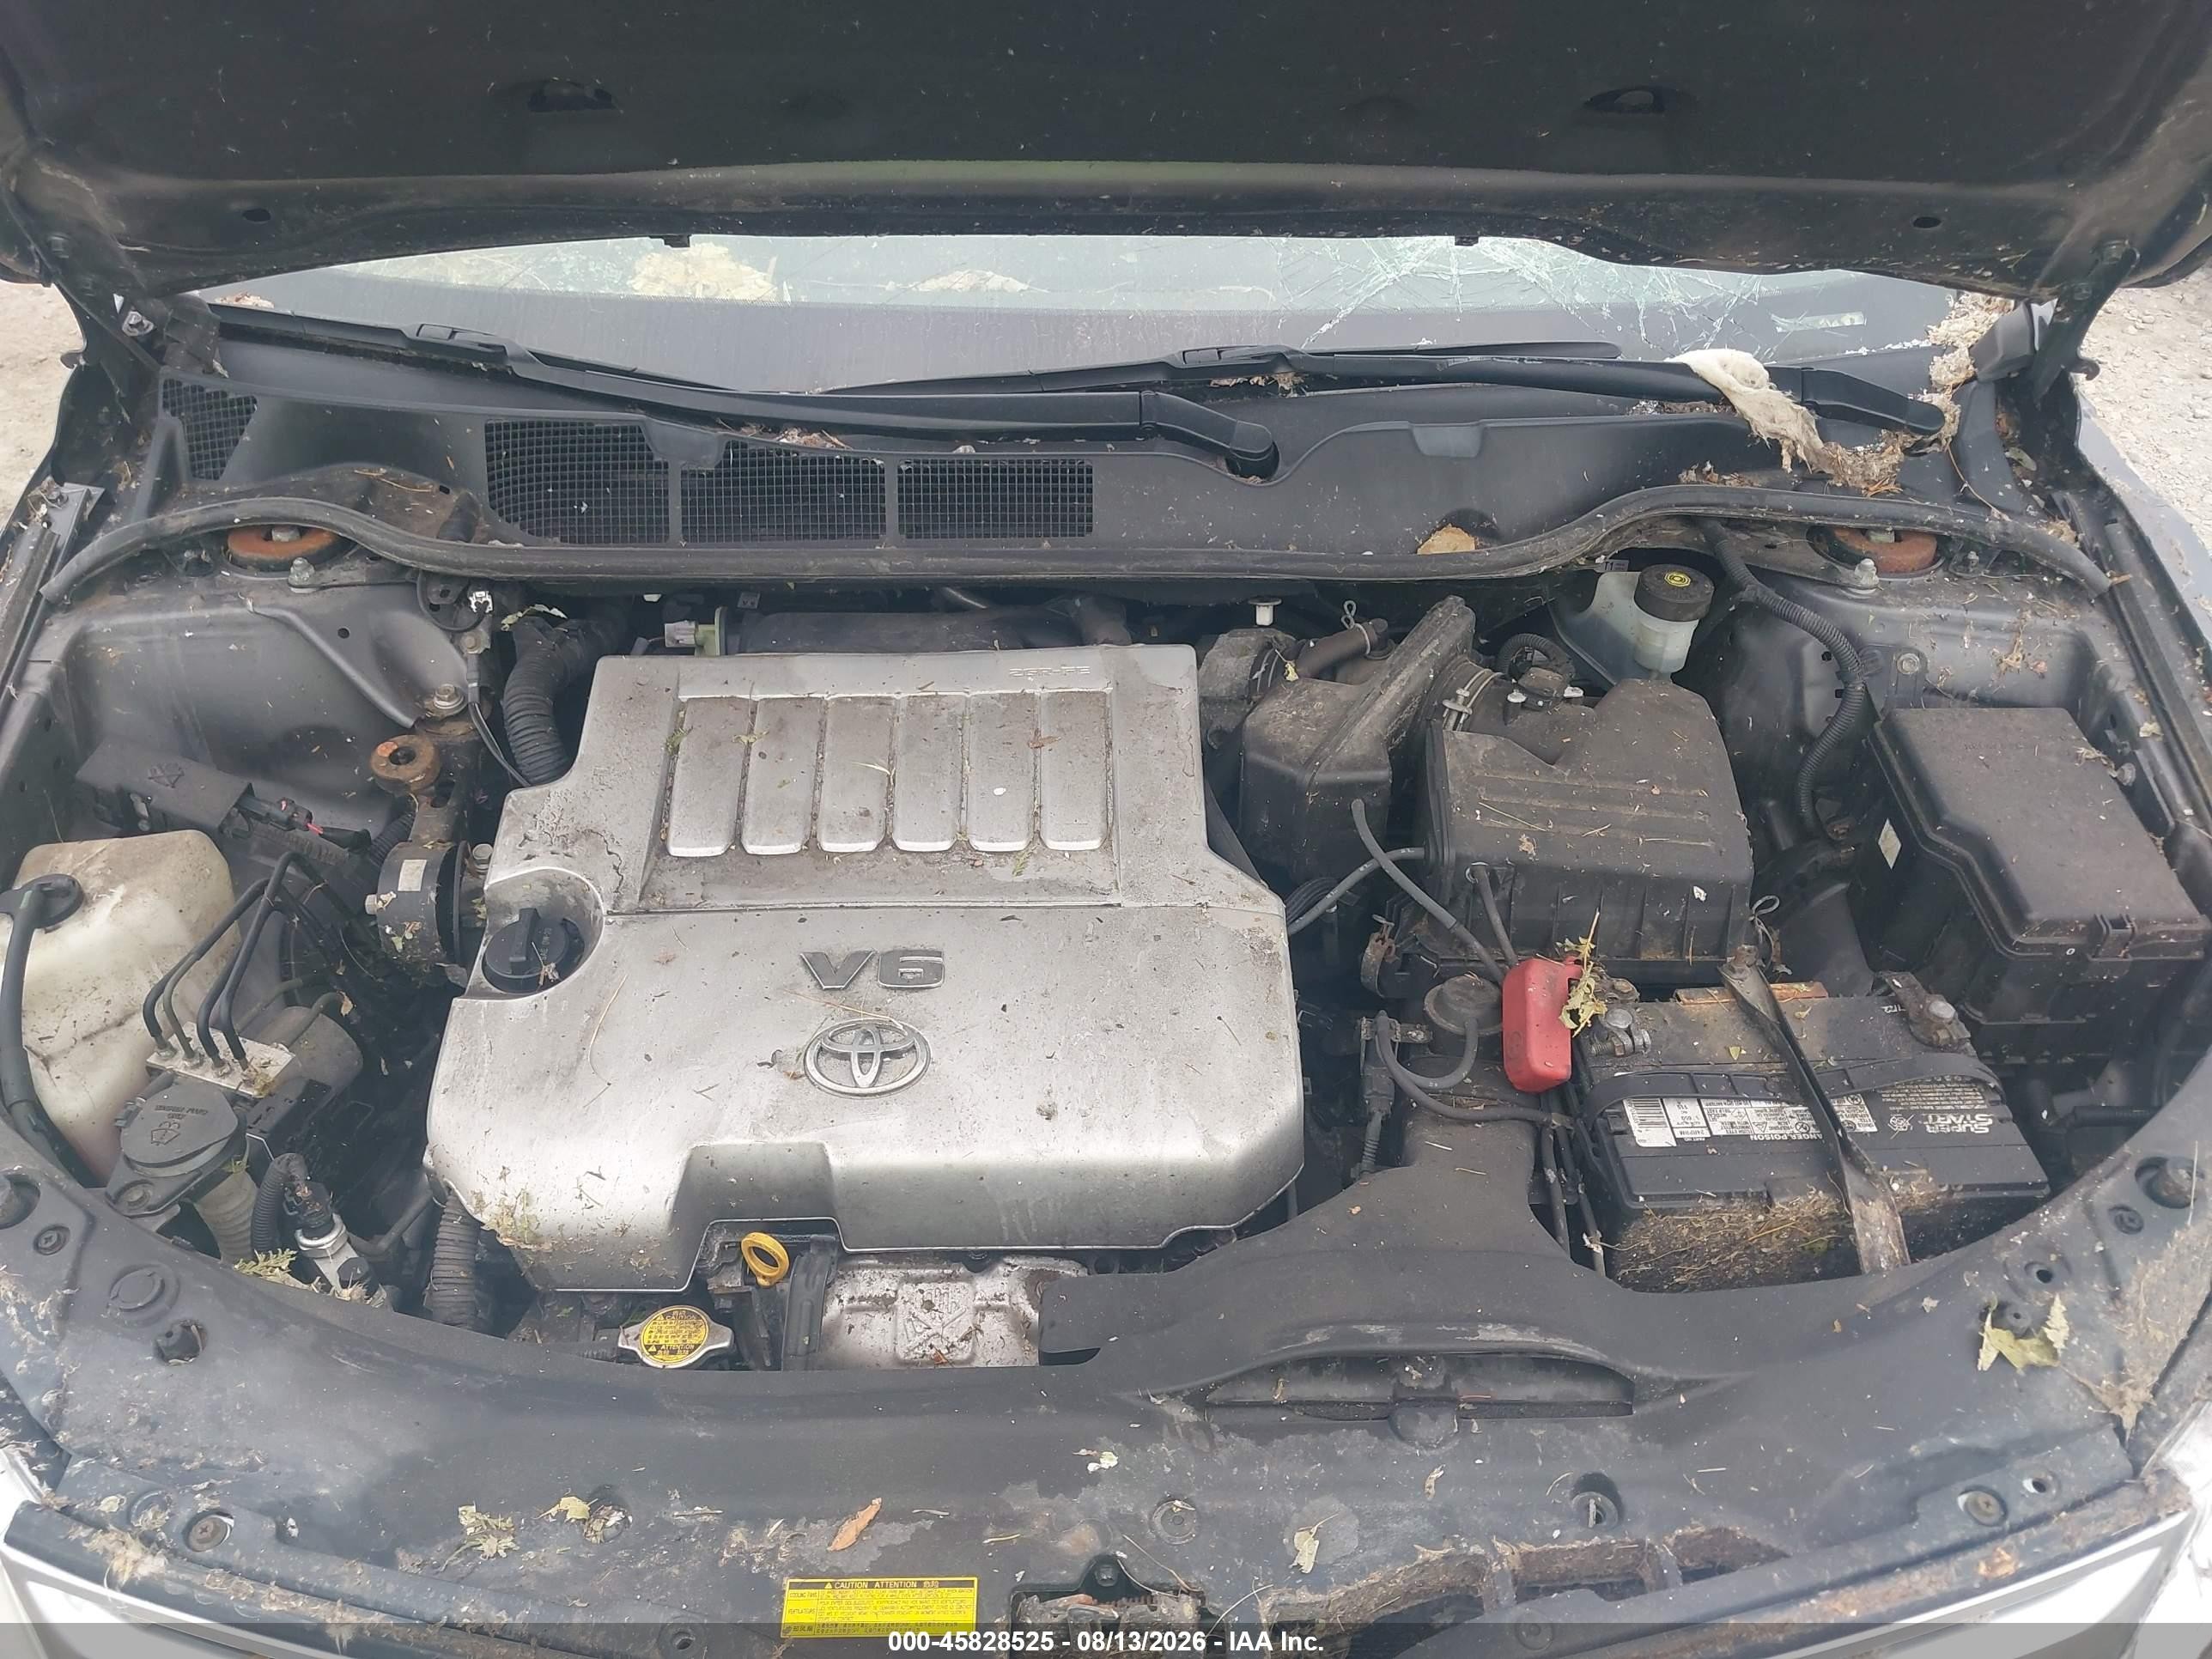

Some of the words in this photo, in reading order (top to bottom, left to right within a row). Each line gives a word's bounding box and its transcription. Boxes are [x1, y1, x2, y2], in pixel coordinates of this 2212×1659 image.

[799, 948, 945, 989] V6
[1923, 1114, 1993, 1125] START
[1925, 1123, 1990, 1134] SUPER
